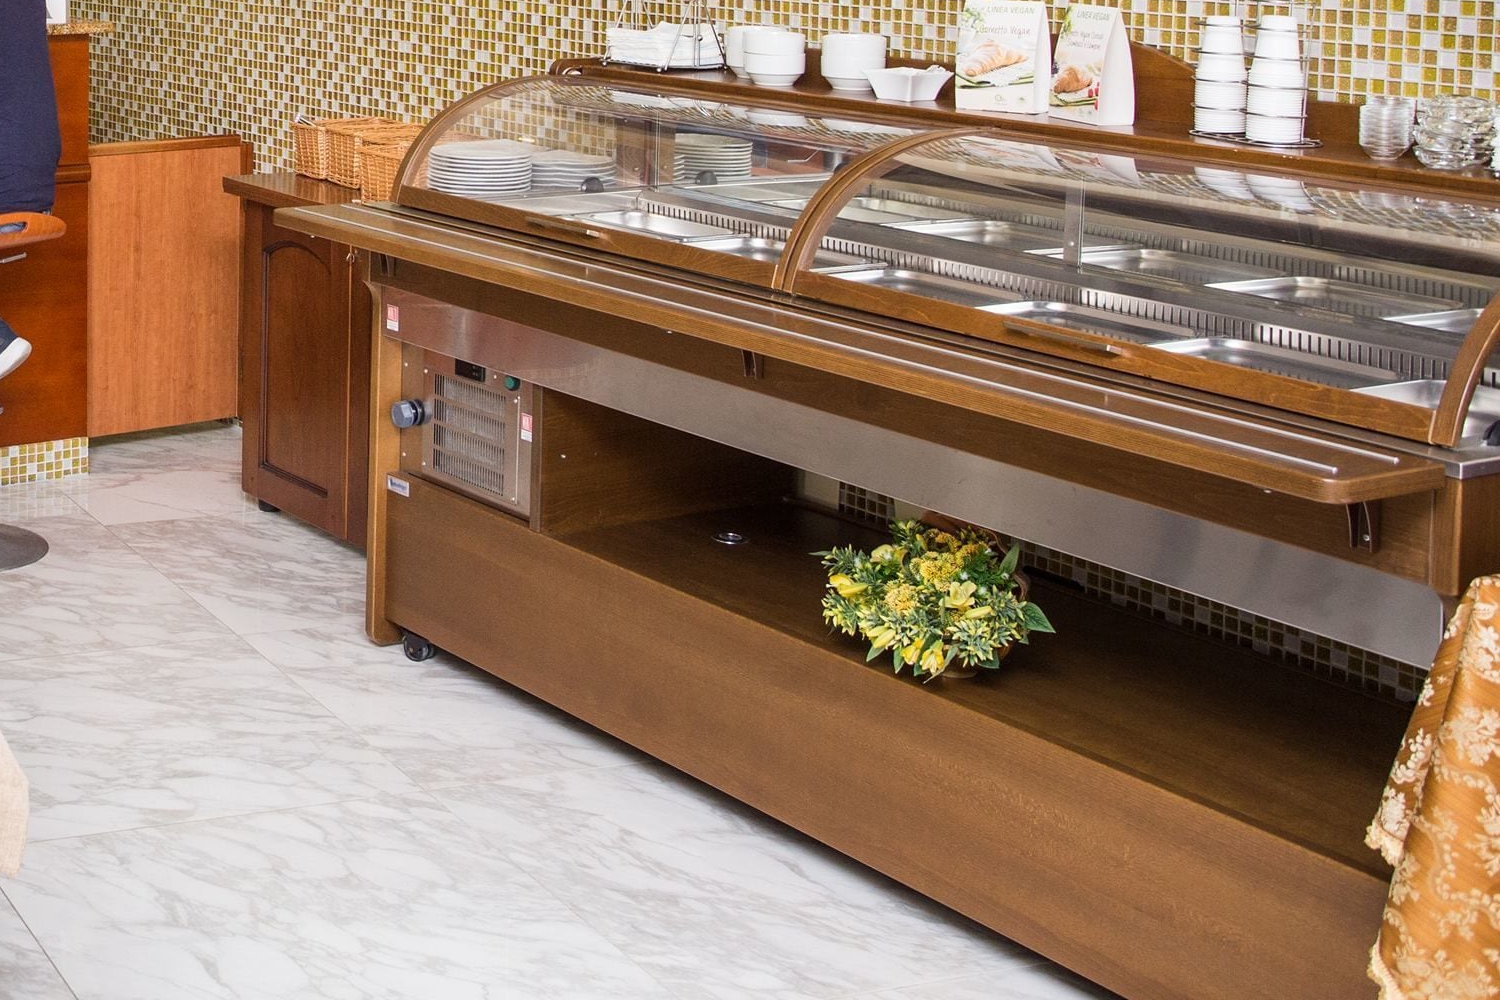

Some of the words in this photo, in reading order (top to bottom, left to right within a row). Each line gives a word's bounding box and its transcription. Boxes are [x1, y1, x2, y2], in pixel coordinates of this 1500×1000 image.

[987, 6, 1008, 14] LINEA
[1010, 7, 1035, 15] VEGAN
[1092, 11, 1110, 21] VEGAN
